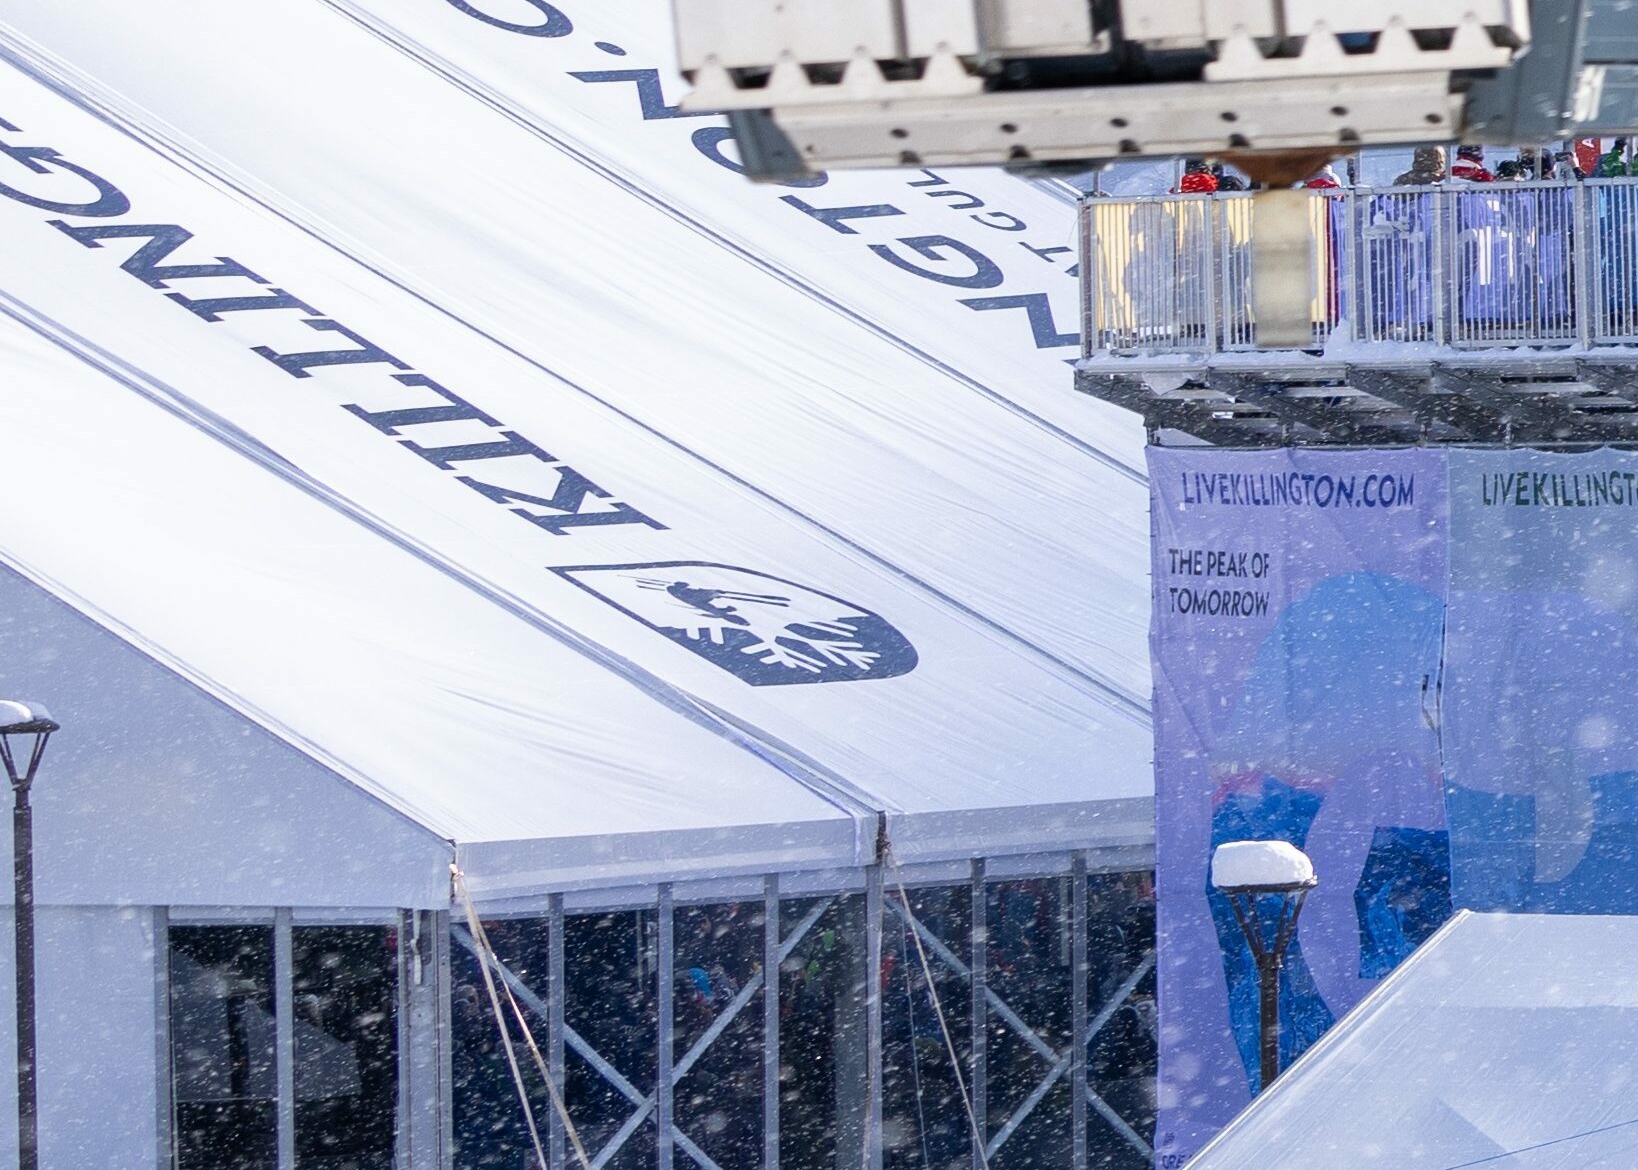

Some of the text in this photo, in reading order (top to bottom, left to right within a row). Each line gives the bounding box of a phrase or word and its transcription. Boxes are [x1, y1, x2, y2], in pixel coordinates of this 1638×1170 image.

[905, 168, 978, 232] GUL
[0, 118, 672, 536] KILLING
[1182, 472, 1414, 508] LIVEKILLINGTON.COM
[1168, 549, 1271, 577] THE PEAK OF
[1169, 585, 1271, 618] TOMORROW
